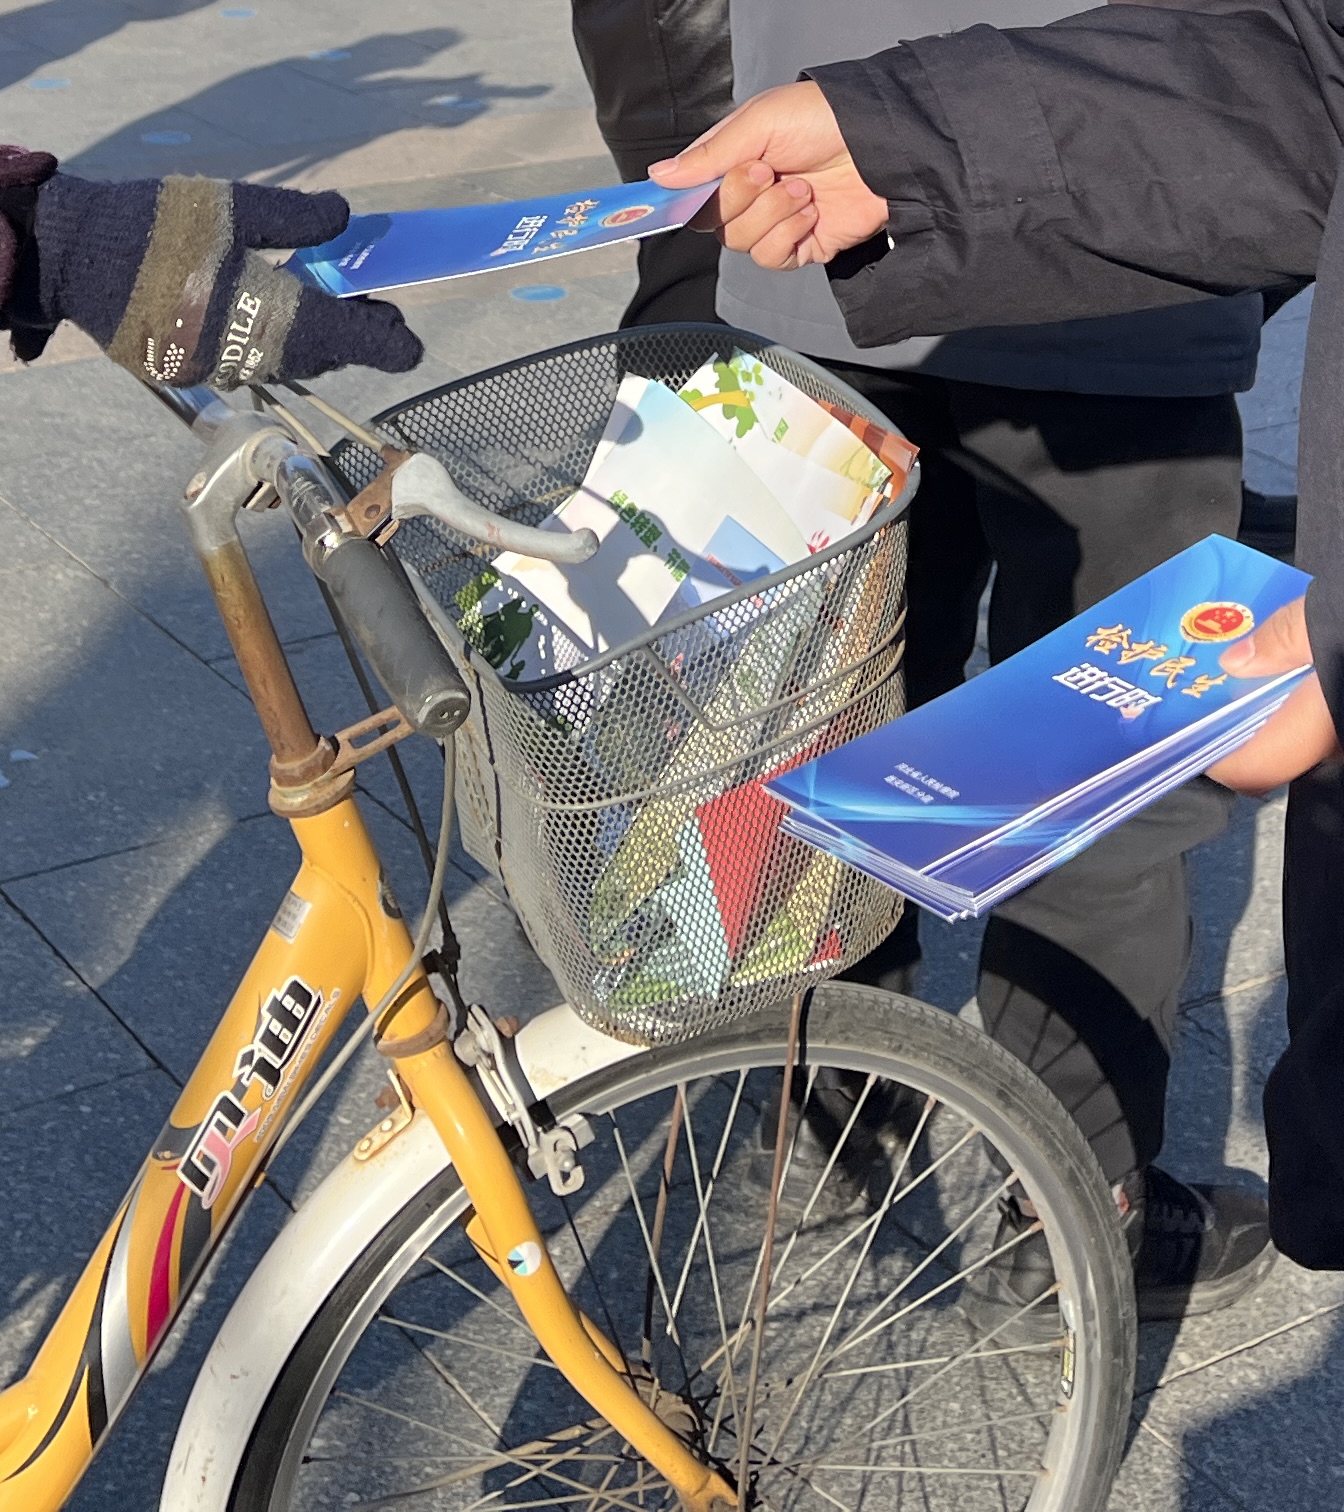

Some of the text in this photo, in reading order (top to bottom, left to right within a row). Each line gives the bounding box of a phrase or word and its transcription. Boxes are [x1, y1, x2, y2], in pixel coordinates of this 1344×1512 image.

[1051, 661, 1163, 720] 进行时
[1084, 624, 1231, 701] 检护民生
